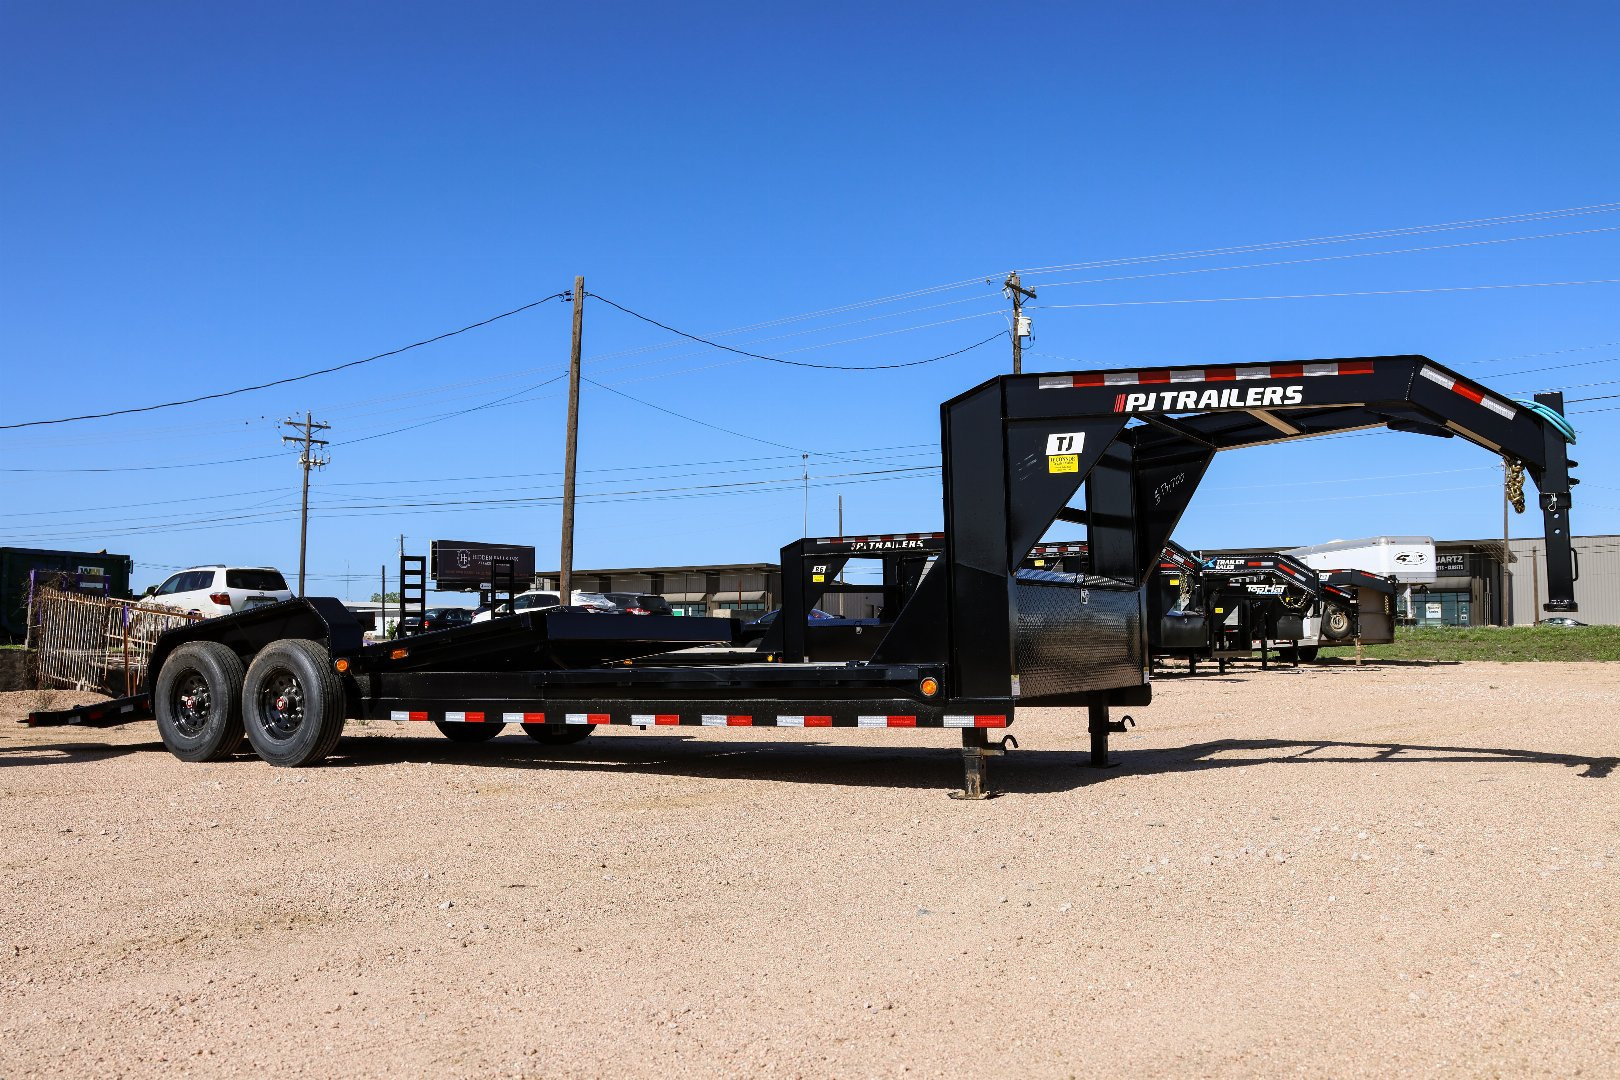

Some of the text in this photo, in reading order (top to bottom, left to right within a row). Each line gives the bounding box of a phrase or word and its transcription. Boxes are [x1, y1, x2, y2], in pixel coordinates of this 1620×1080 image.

[1125, 385, 1304, 412] PJ TRAILERS
[1056, 435, 1074, 452] TJ
[869, 540, 924, 550] TRAILERS
[1436, 555, 1464, 563] UARTZ
